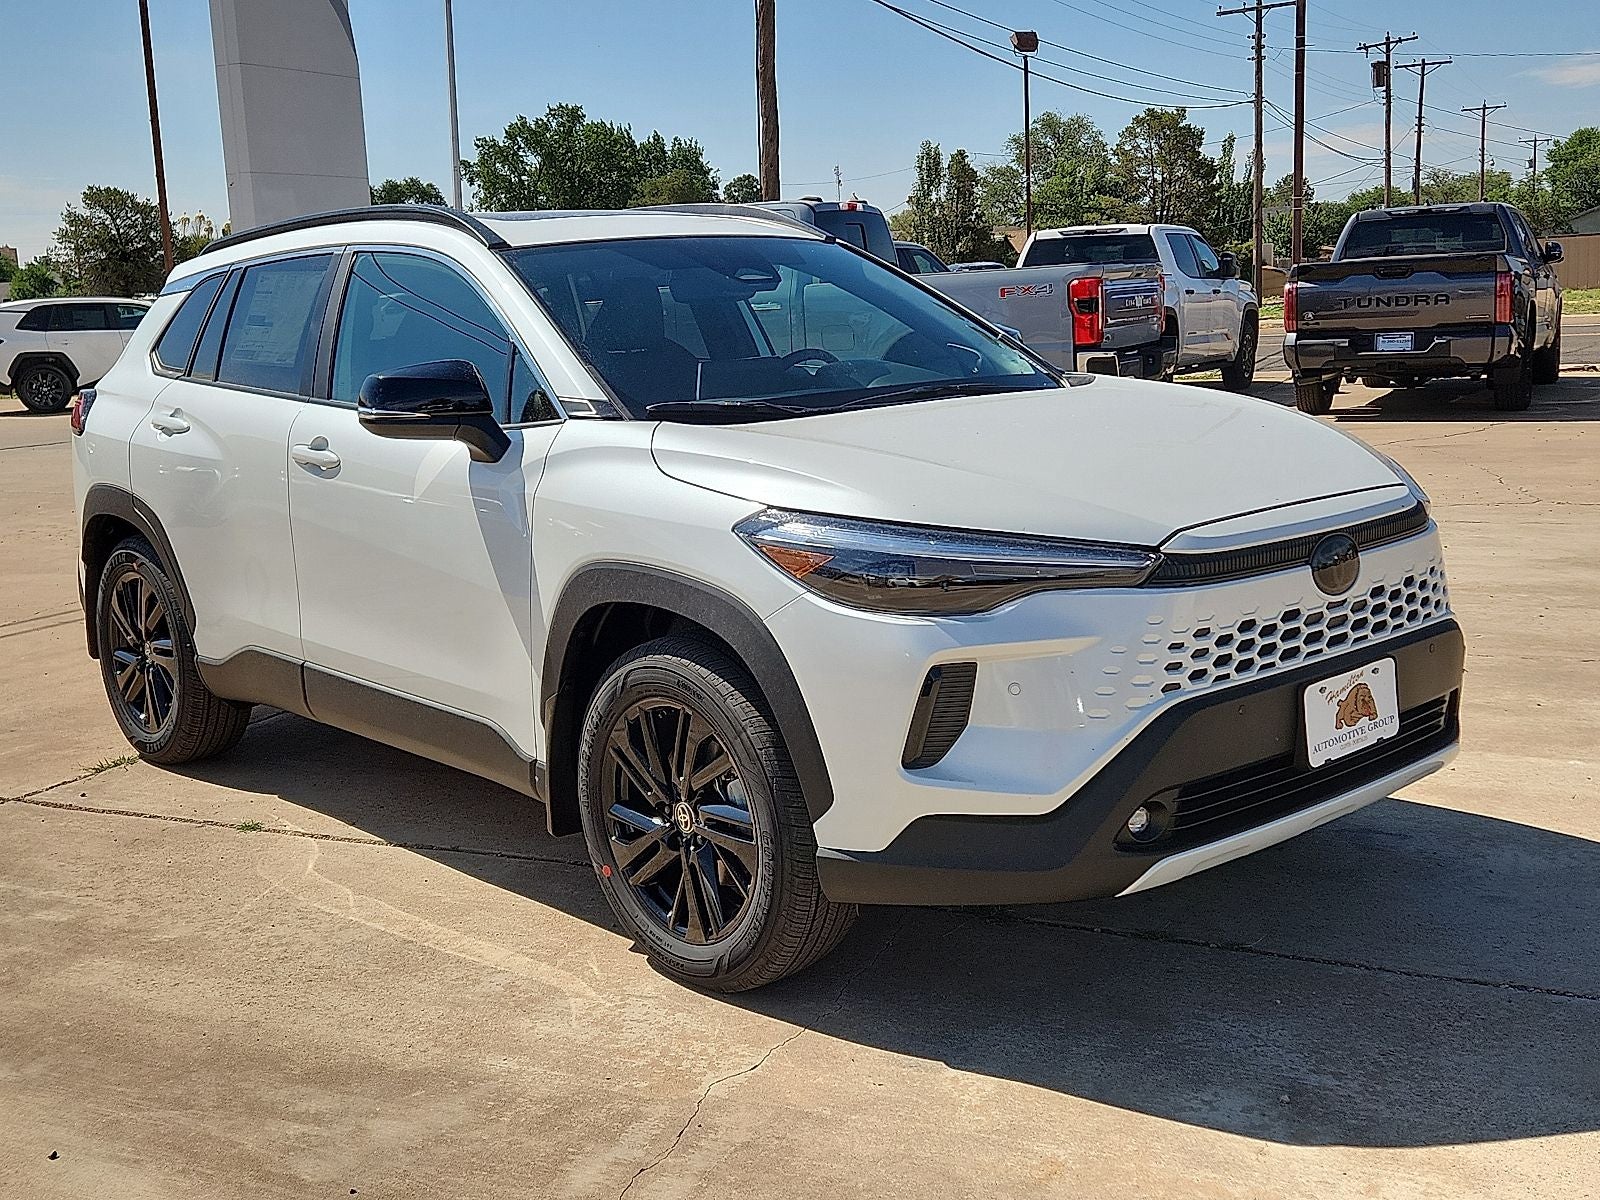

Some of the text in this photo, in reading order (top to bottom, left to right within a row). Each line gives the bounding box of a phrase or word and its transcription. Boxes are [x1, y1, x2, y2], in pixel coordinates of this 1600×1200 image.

[999, 283, 1054, 299] FX4
[1337, 293, 1451, 310] TUNDRA
[1312, 724, 1367, 755] AUTOMOTIVE
[1366, 714, 1395, 733] GROUP
